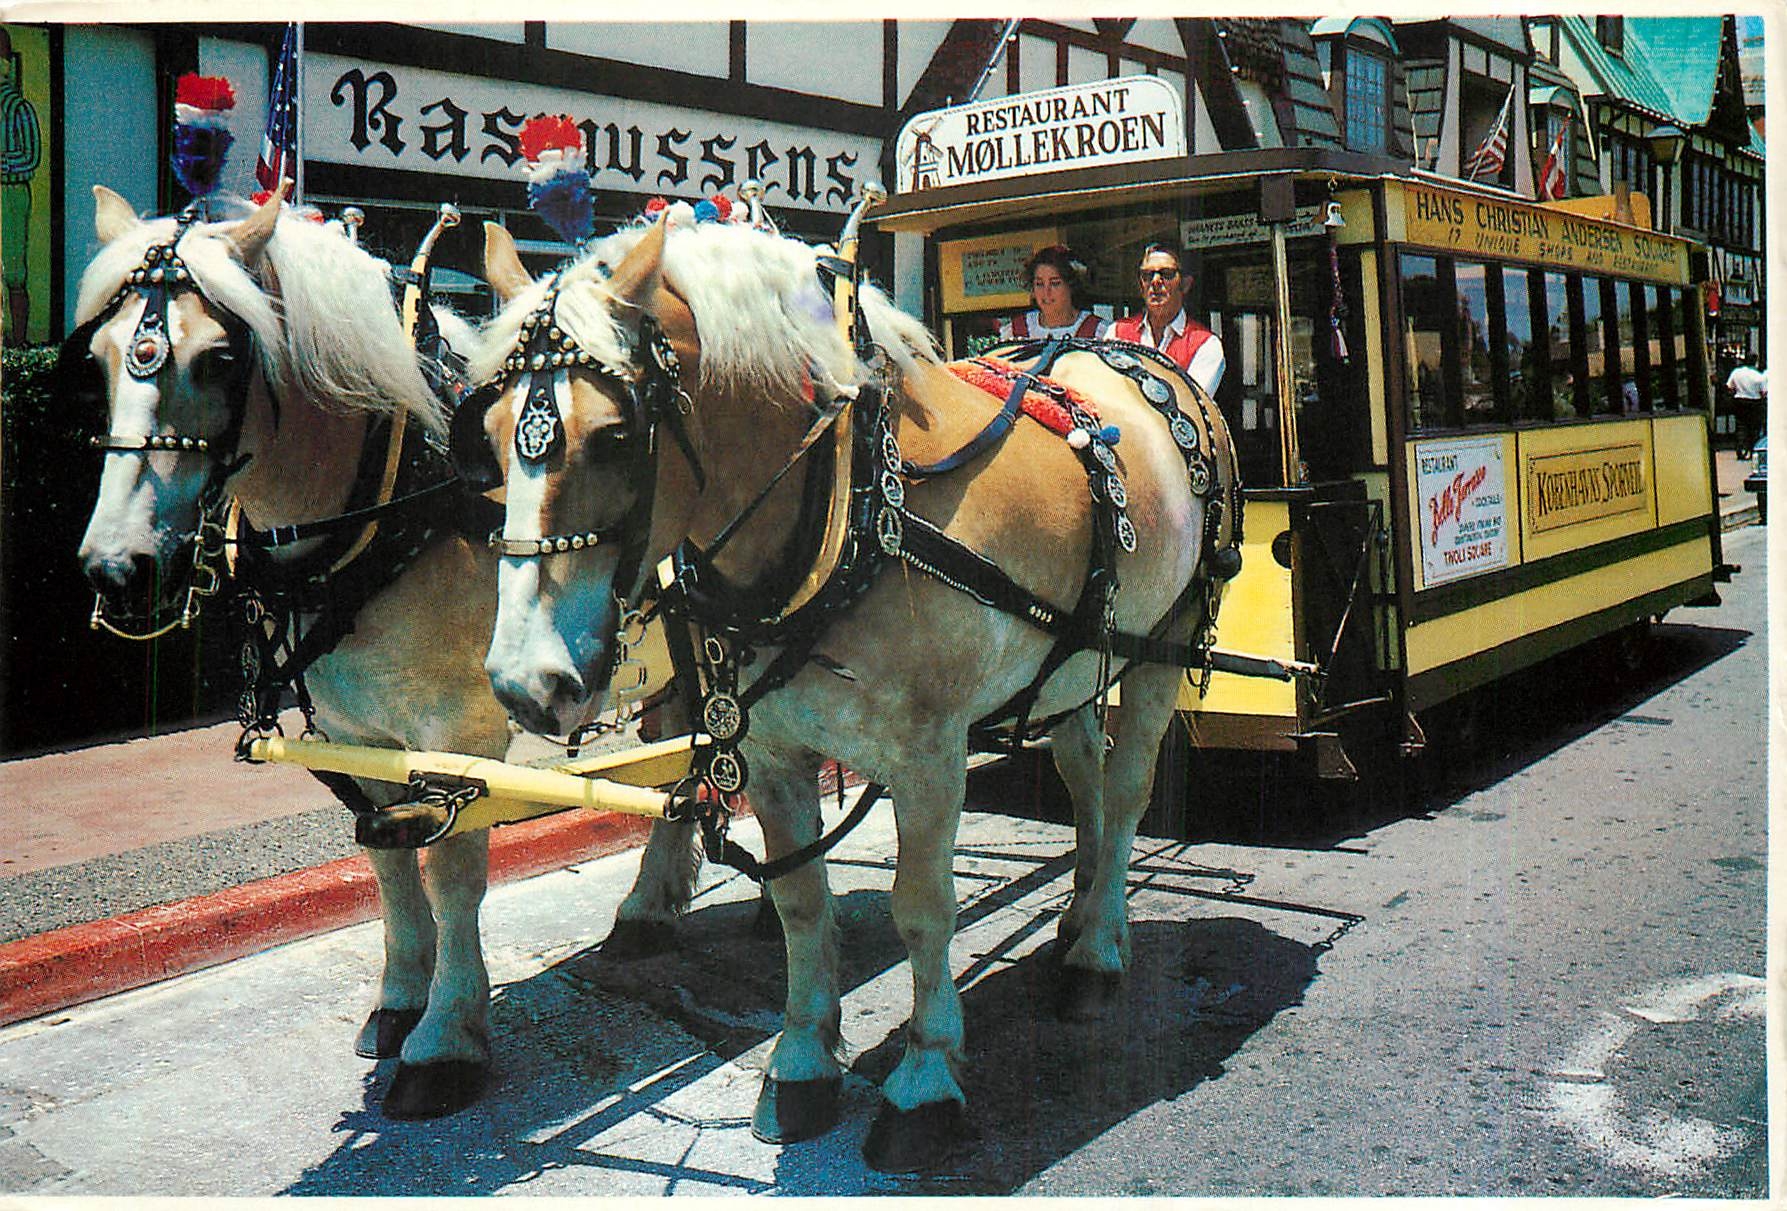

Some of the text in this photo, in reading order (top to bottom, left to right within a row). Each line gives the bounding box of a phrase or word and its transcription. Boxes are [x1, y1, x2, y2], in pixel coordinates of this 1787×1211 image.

[966, 88, 1129, 136] RESTAURANT
[946, 112, 1166, 179] MØLLEKROEN
[1416, 191, 1465, 225] HANS
[1475, 202, 1549, 239] CHRISTIAN
